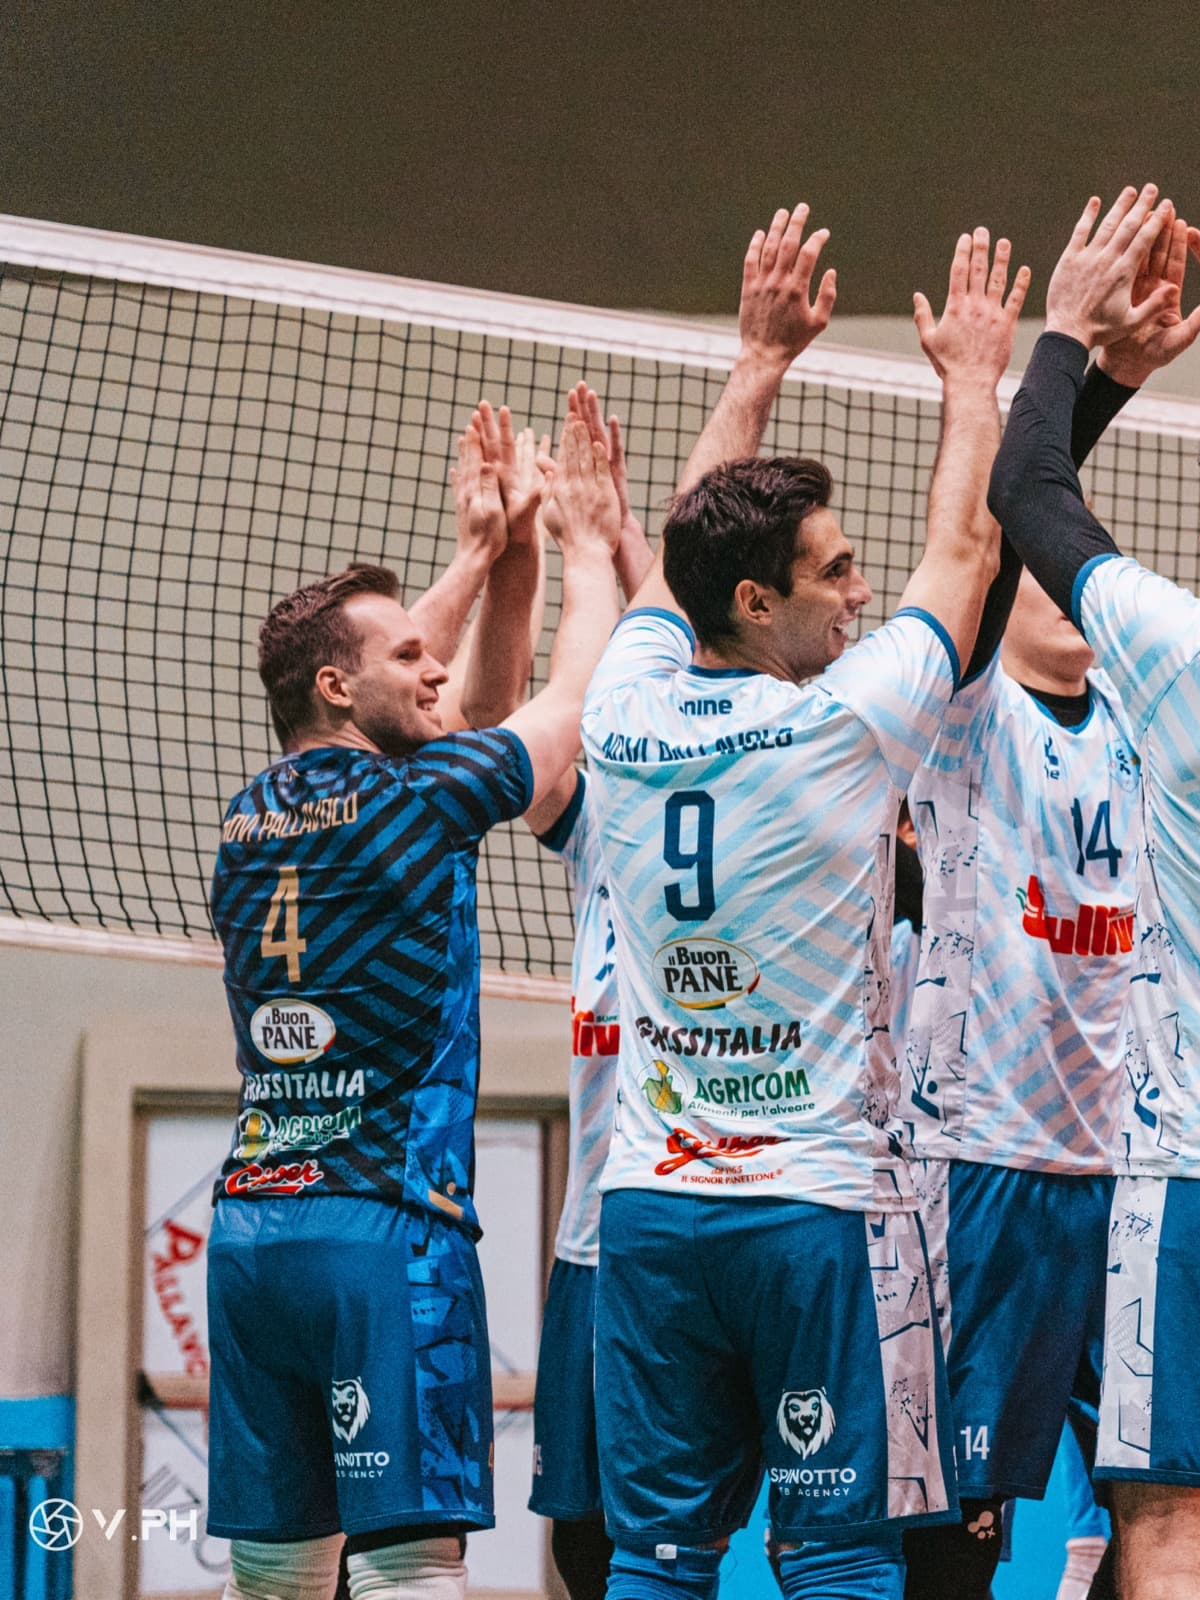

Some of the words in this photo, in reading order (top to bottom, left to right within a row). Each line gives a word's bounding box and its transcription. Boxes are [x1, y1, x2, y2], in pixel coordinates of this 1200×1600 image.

[1070, 798, 1122, 878] 14
[663, 790, 716, 922] 9
[261, 866, 306, 983] 4
[675, 946, 731, 966] Buon
[663, 965, 743, 993] PANE
[271, 1008, 310, 1025] Buon
[262, 1026, 320, 1050] PANE
[694, 1069, 811, 1105] AGRICOM
[741, 1109, 760, 1119] per
[762, 1102, 816, 1116] l'alveare
[690, 1176, 724, 1185] SIGNOR
[960, 1425, 991, 1461] 14
[770, 1467, 857, 1486] SPINOTTO
[797, 1487, 851, 1497] AGENCY
